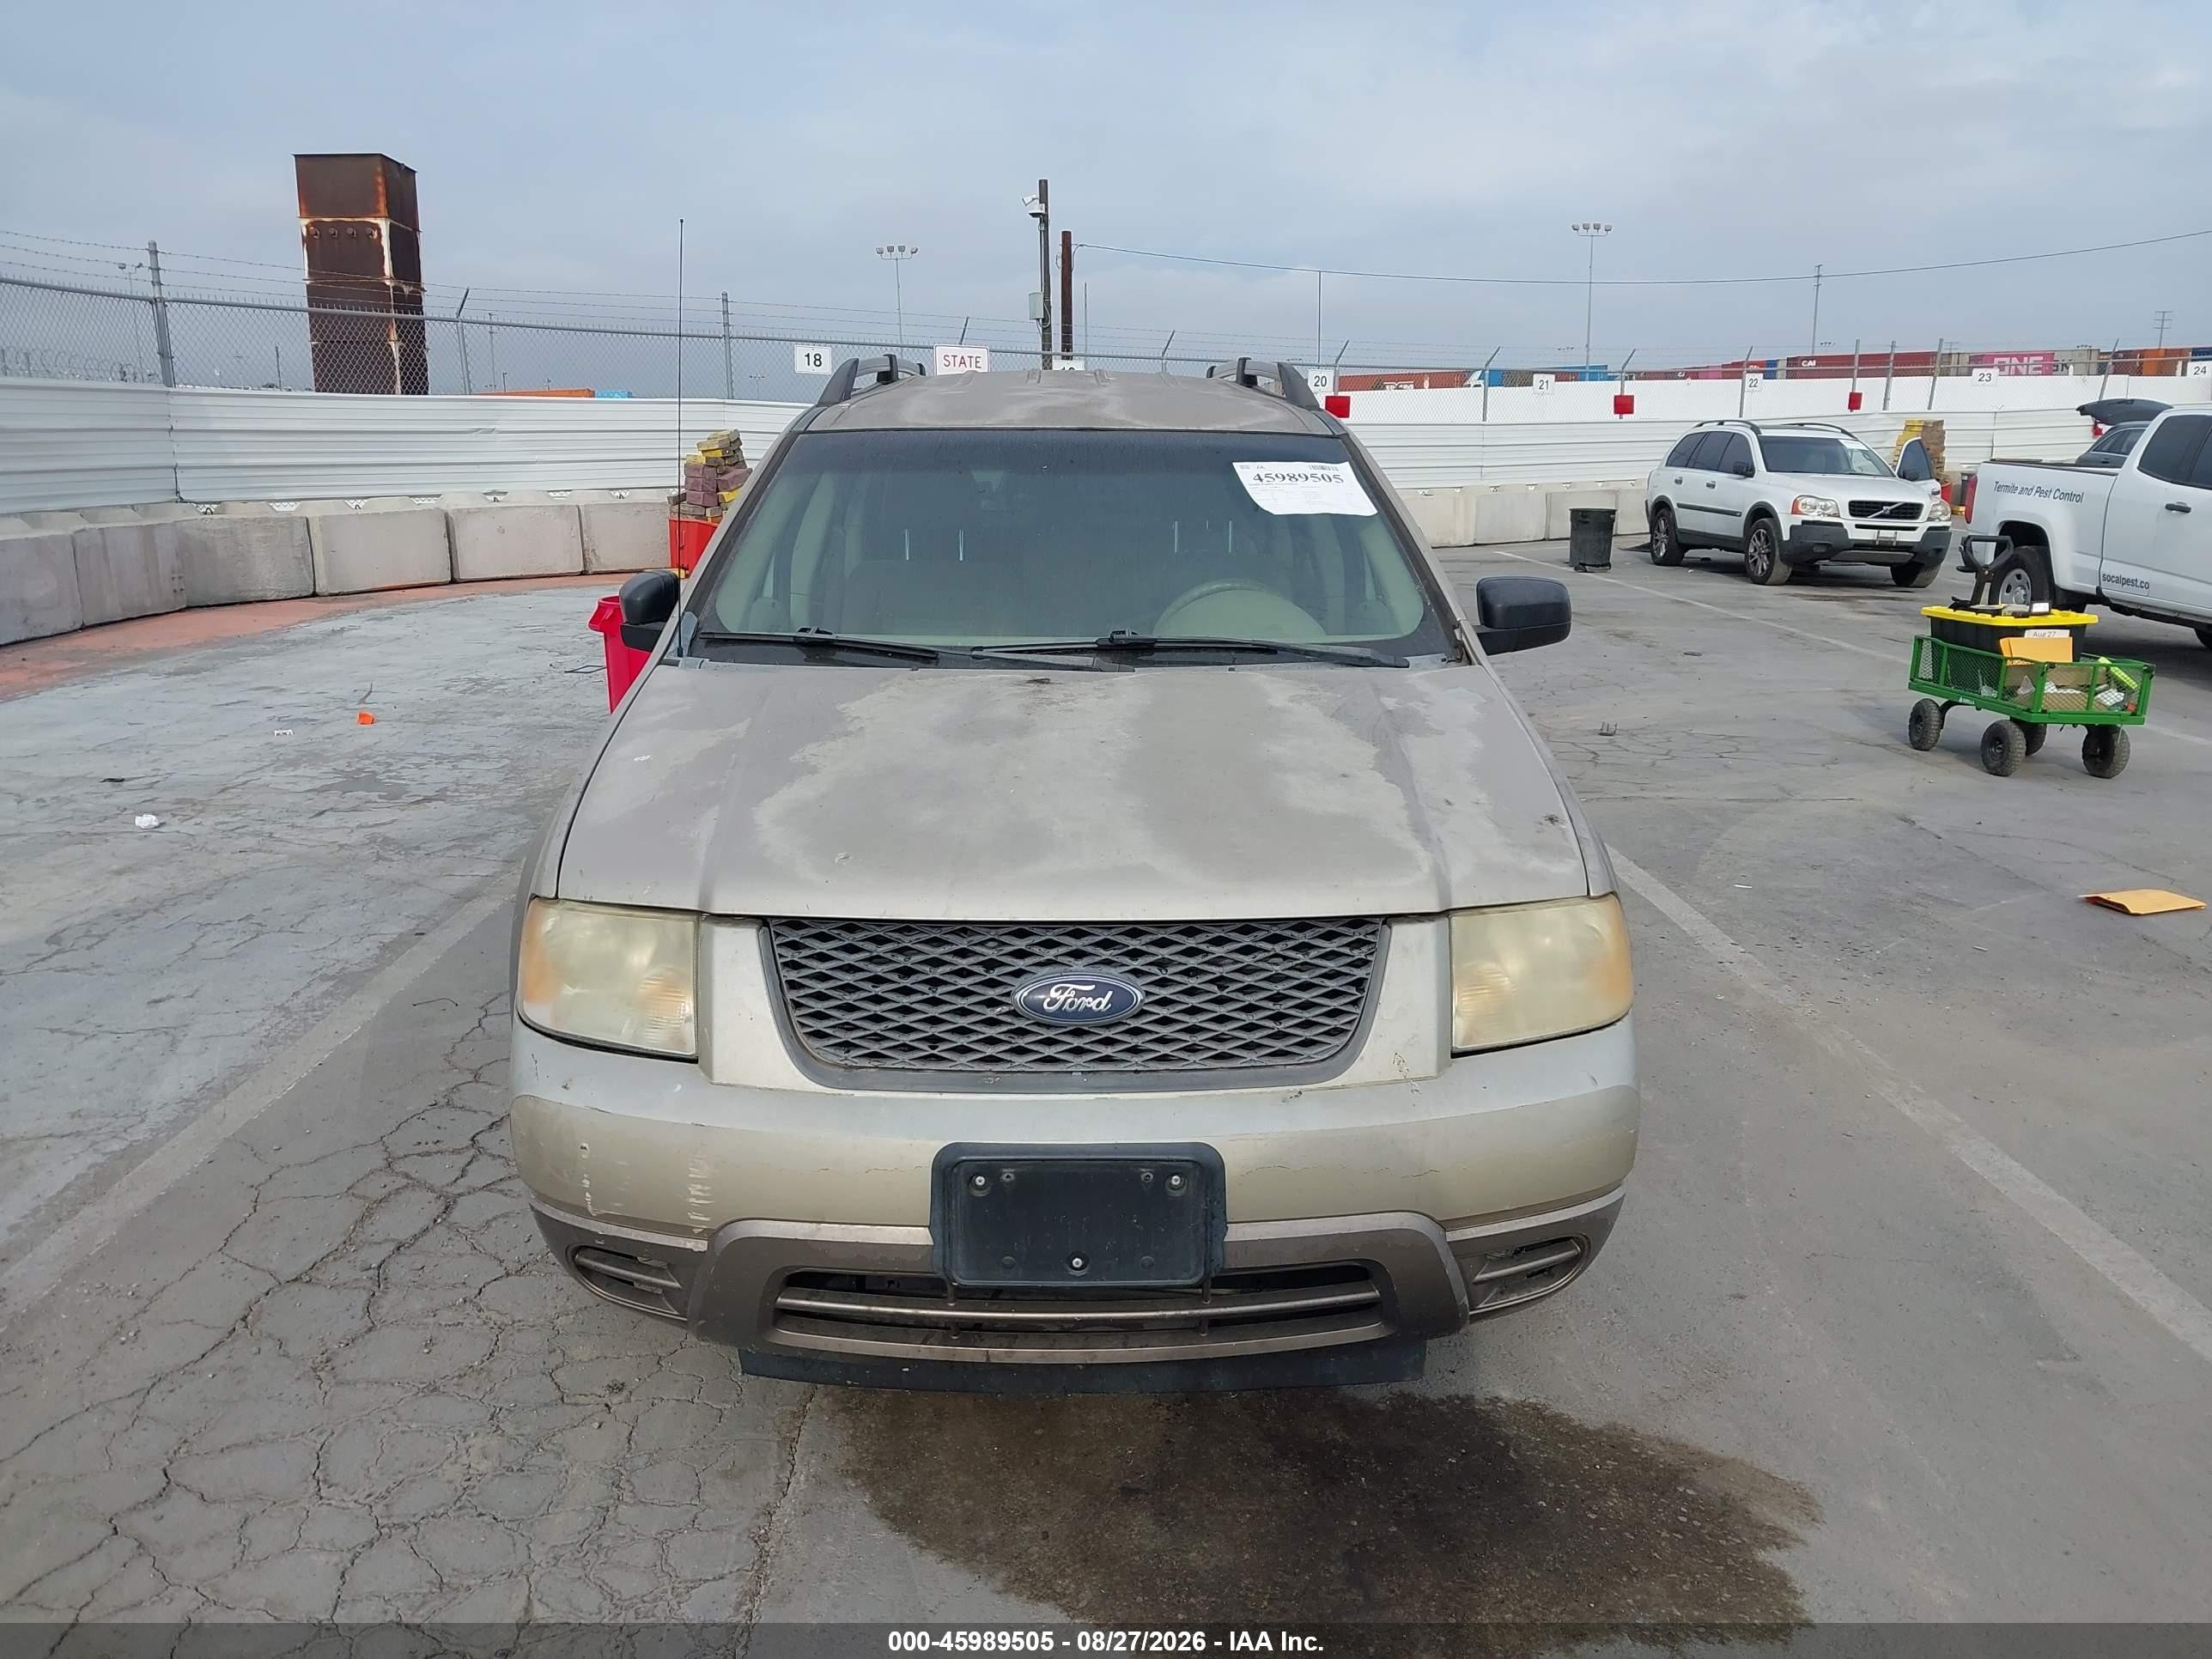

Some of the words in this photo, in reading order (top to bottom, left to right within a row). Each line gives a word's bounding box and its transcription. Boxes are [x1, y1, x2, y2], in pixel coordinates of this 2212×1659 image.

[804, 352, 823, 368] 18
[943, 355, 982, 369] STATE
[2193, 366, 2207, 375] 24
[1314, 375, 1328, 387] 20
[1748, 378, 1759, 388] 22
[1978, 373, 1992, 382] 23
[1538, 380, 1549, 391] 21
[1253, 472, 1344, 484] 45989505
[1993, 481, 2019, 495] Termite
[2018, 484, 2034, 496] and
[2034, 486, 2051, 499] Pest
[2052, 489, 2084, 503] Control
[2101, 572, 2150, 591] socalpest.co
[1042, 983, 1113, 1012] Ford
